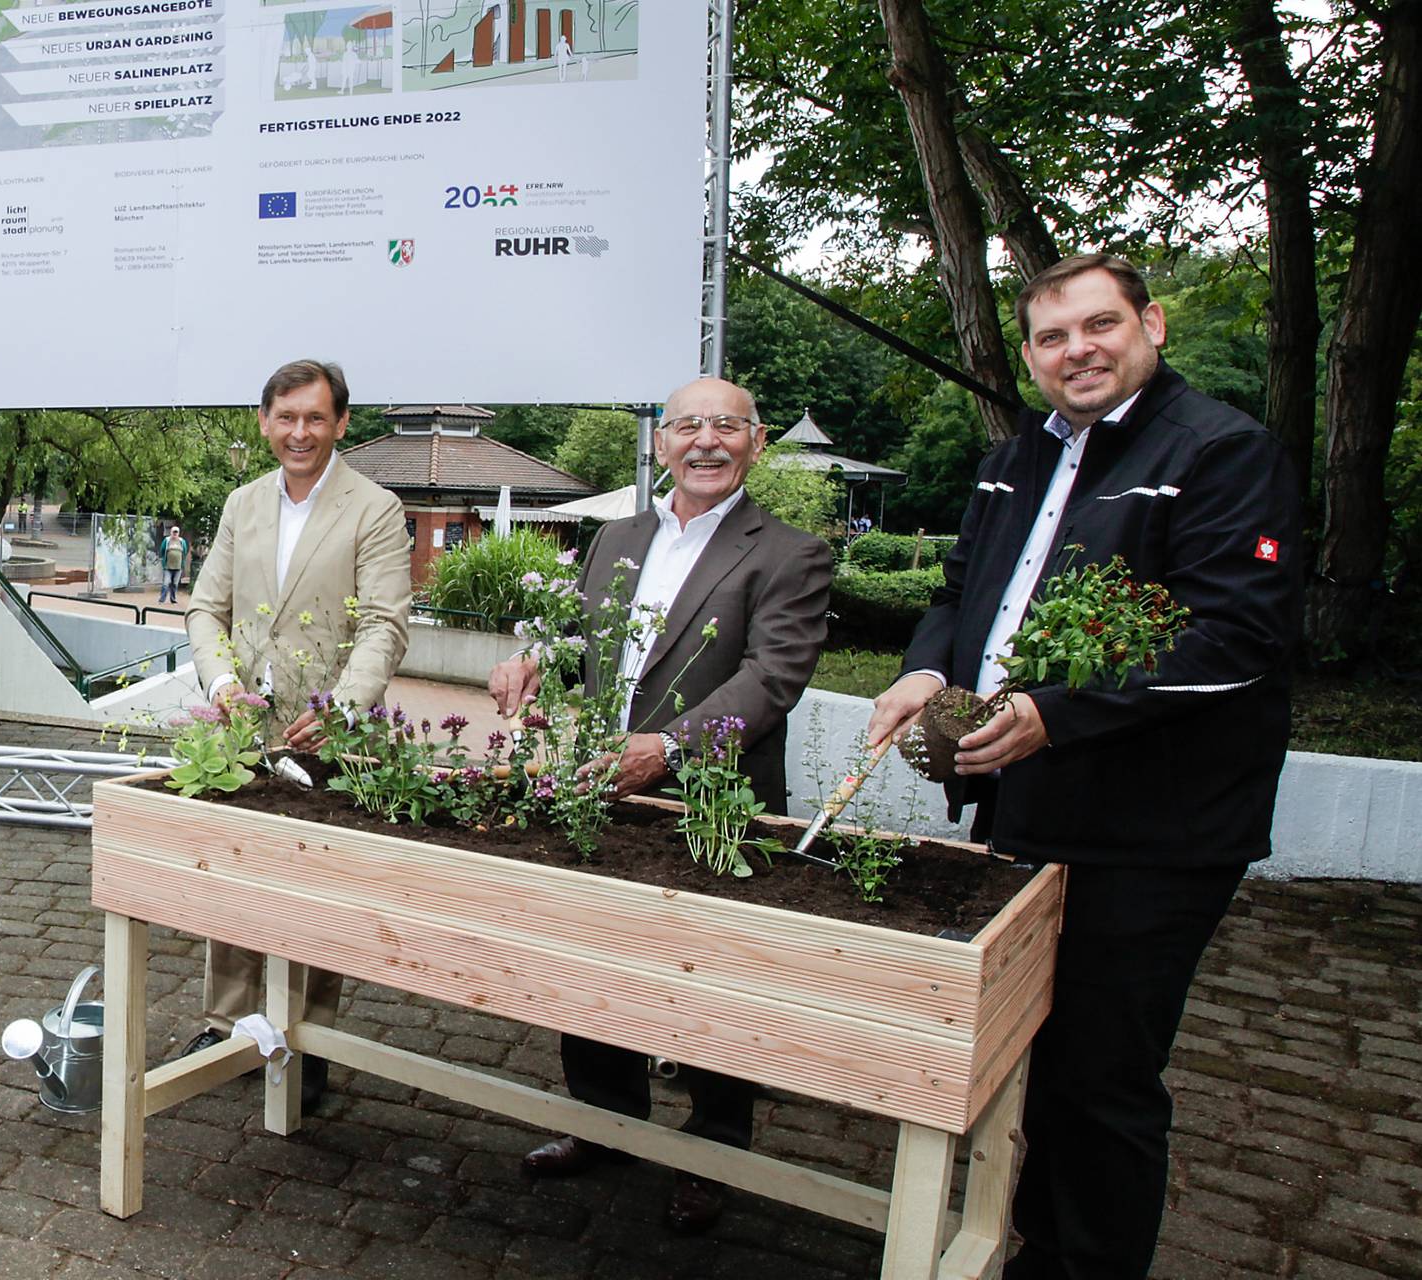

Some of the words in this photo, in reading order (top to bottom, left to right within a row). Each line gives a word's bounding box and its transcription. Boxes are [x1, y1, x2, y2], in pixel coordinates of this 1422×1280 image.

[22, 13, 55, 24] NEUE
[58, 0, 213, 21] BEWEGUNGSANGEBOTE
[41, 43, 82, 55] NEUES
[86, 38, 131, 51] URBAN
[135, 31, 213, 47] GARDENING
[68, 72, 110, 84] NEUER
[114, 63, 213, 80] SALINENPLATZ
[88, 102, 130, 115] NEUER
[134, 95, 213, 111] SPIELPLATZ
[259, 116, 380, 133] FERTIGSTELLUNG
[383, 113, 422, 125] ENDE
[425, 111, 461, 123] 2022
[304, 157, 330, 167] DURCH
[400, 152, 425, 161] UNION
[6, 205, 27, 214] licht
[1, 217, 27, 225] raum
[2, 226, 27, 235] stadt
[29, 224, 64, 236] planung
[494, 225, 594, 236] REGIONALVERBAND
[495, 237, 571, 256] RUHR
